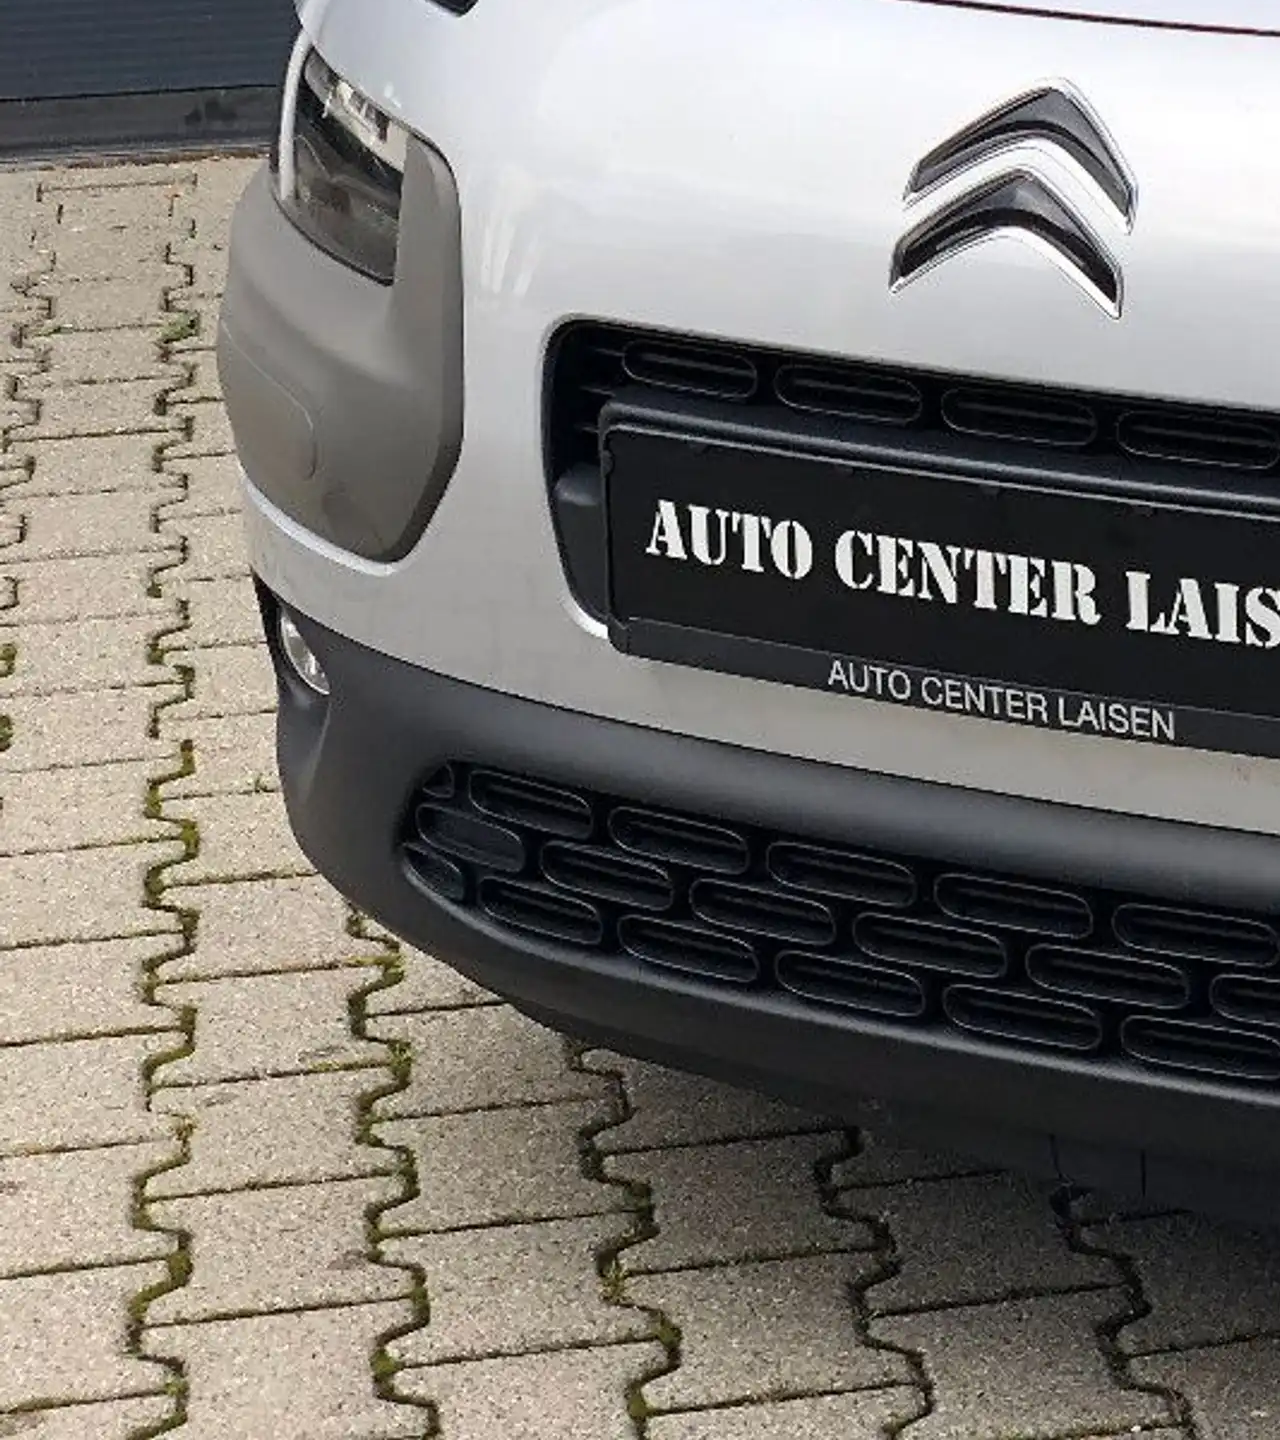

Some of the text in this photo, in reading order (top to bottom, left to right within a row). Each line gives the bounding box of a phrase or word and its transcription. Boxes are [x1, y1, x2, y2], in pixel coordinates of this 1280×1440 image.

[642, 496, 814, 582] AUTO
[833, 528, 1102, 627] CENTER
[826, 658, 1176, 742] AUTO CENTER LAISEN
